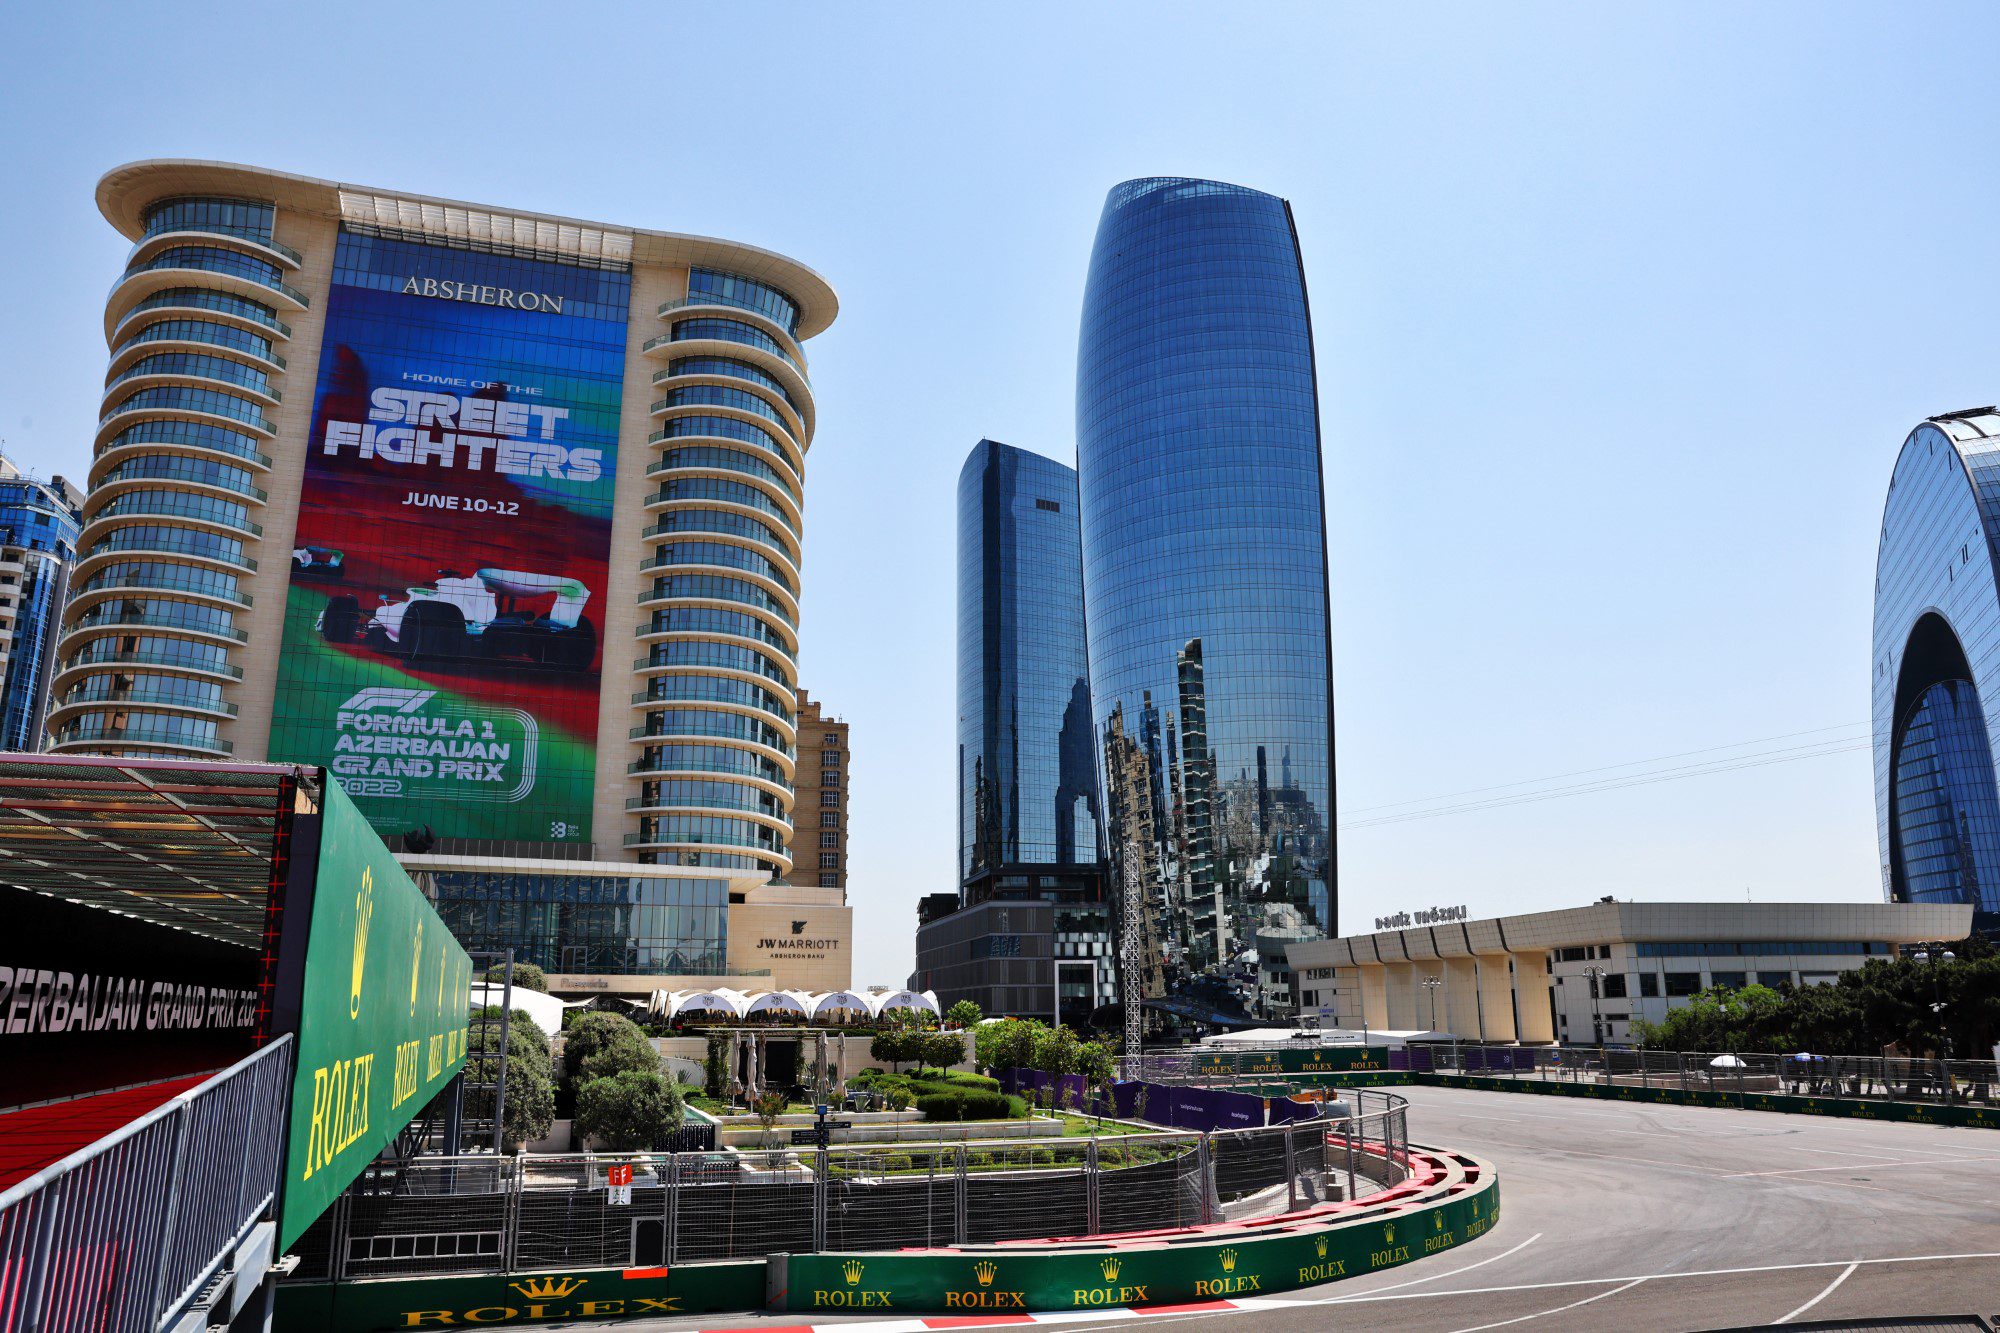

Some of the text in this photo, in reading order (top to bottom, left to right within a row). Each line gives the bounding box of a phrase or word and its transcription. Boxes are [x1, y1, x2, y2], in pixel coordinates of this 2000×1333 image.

[402, 276, 563, 314] ABSHERON
[402, 372, 544, 396] HOME OF THE
[369, 387, 569, 440] STREET
[323, 419, 603, 481] FIGHTERS
[402, 492, 520, 516] JUNE 10-12
[336, 712, 496, 740] FORMULA 1
[333, 733, 511, 761] AZERBAIJAN
[332, 754, 506, 782] GRAND PRIX
[756, 939, 839, 950] JW MARRIOTT
[146, 981, 206, 1030] GRAND
[206, 987, 239, 1029] PRIX
[392, 1040, 420, 1110] ROLEX
[1201, 1066, 1233, 1074] ROLEX
[1302, 1062, 1333, 1071] ROLEX
[1350, 1061, 1380, 1070] ROLEX
[304, 1053, 374, 1182] ROLEX
[1907, 1114, 1933, 1122] ROLEX
[1967, 1119, 1995, 1127] ROLEX
[613, 1169, 620, 1184] F
[621, 1167, 627, 1184] F
[1425, 1231, 1454, 1252] ROLEX
[1371, 1246, 1410, 1267] ROLEX
[1298, 1260, 1346, 1283] ROLEX
[1073, 1285, 1149, 1306] ROLEX
[1194, 1274, 1261, 1296] ROLEX
[813, 1290, 892, 1307] ROLEX
[945, 1291, 1026, 1308] ROLEX
[400, 1297, 686, 1327] ROLEX
